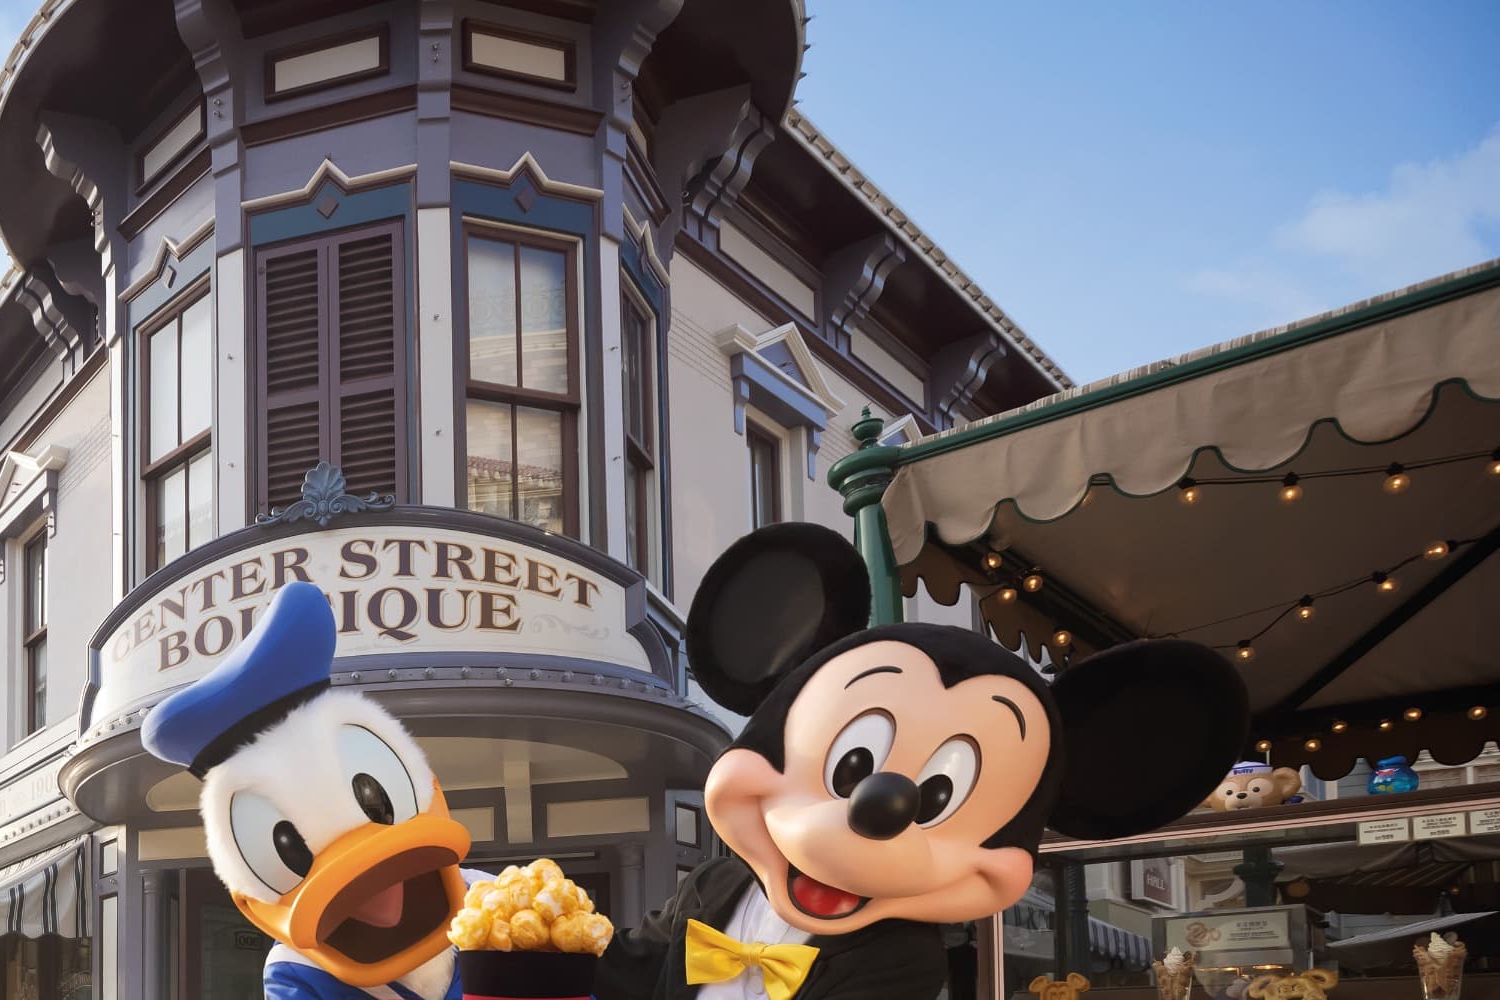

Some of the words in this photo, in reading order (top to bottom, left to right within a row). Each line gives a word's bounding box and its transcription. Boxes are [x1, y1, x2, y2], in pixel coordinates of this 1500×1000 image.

[112, 546, 313, 663] CENTER
[338, 538, 600, 609] STREET
[158, 586, 523, 672] BOIQUE
